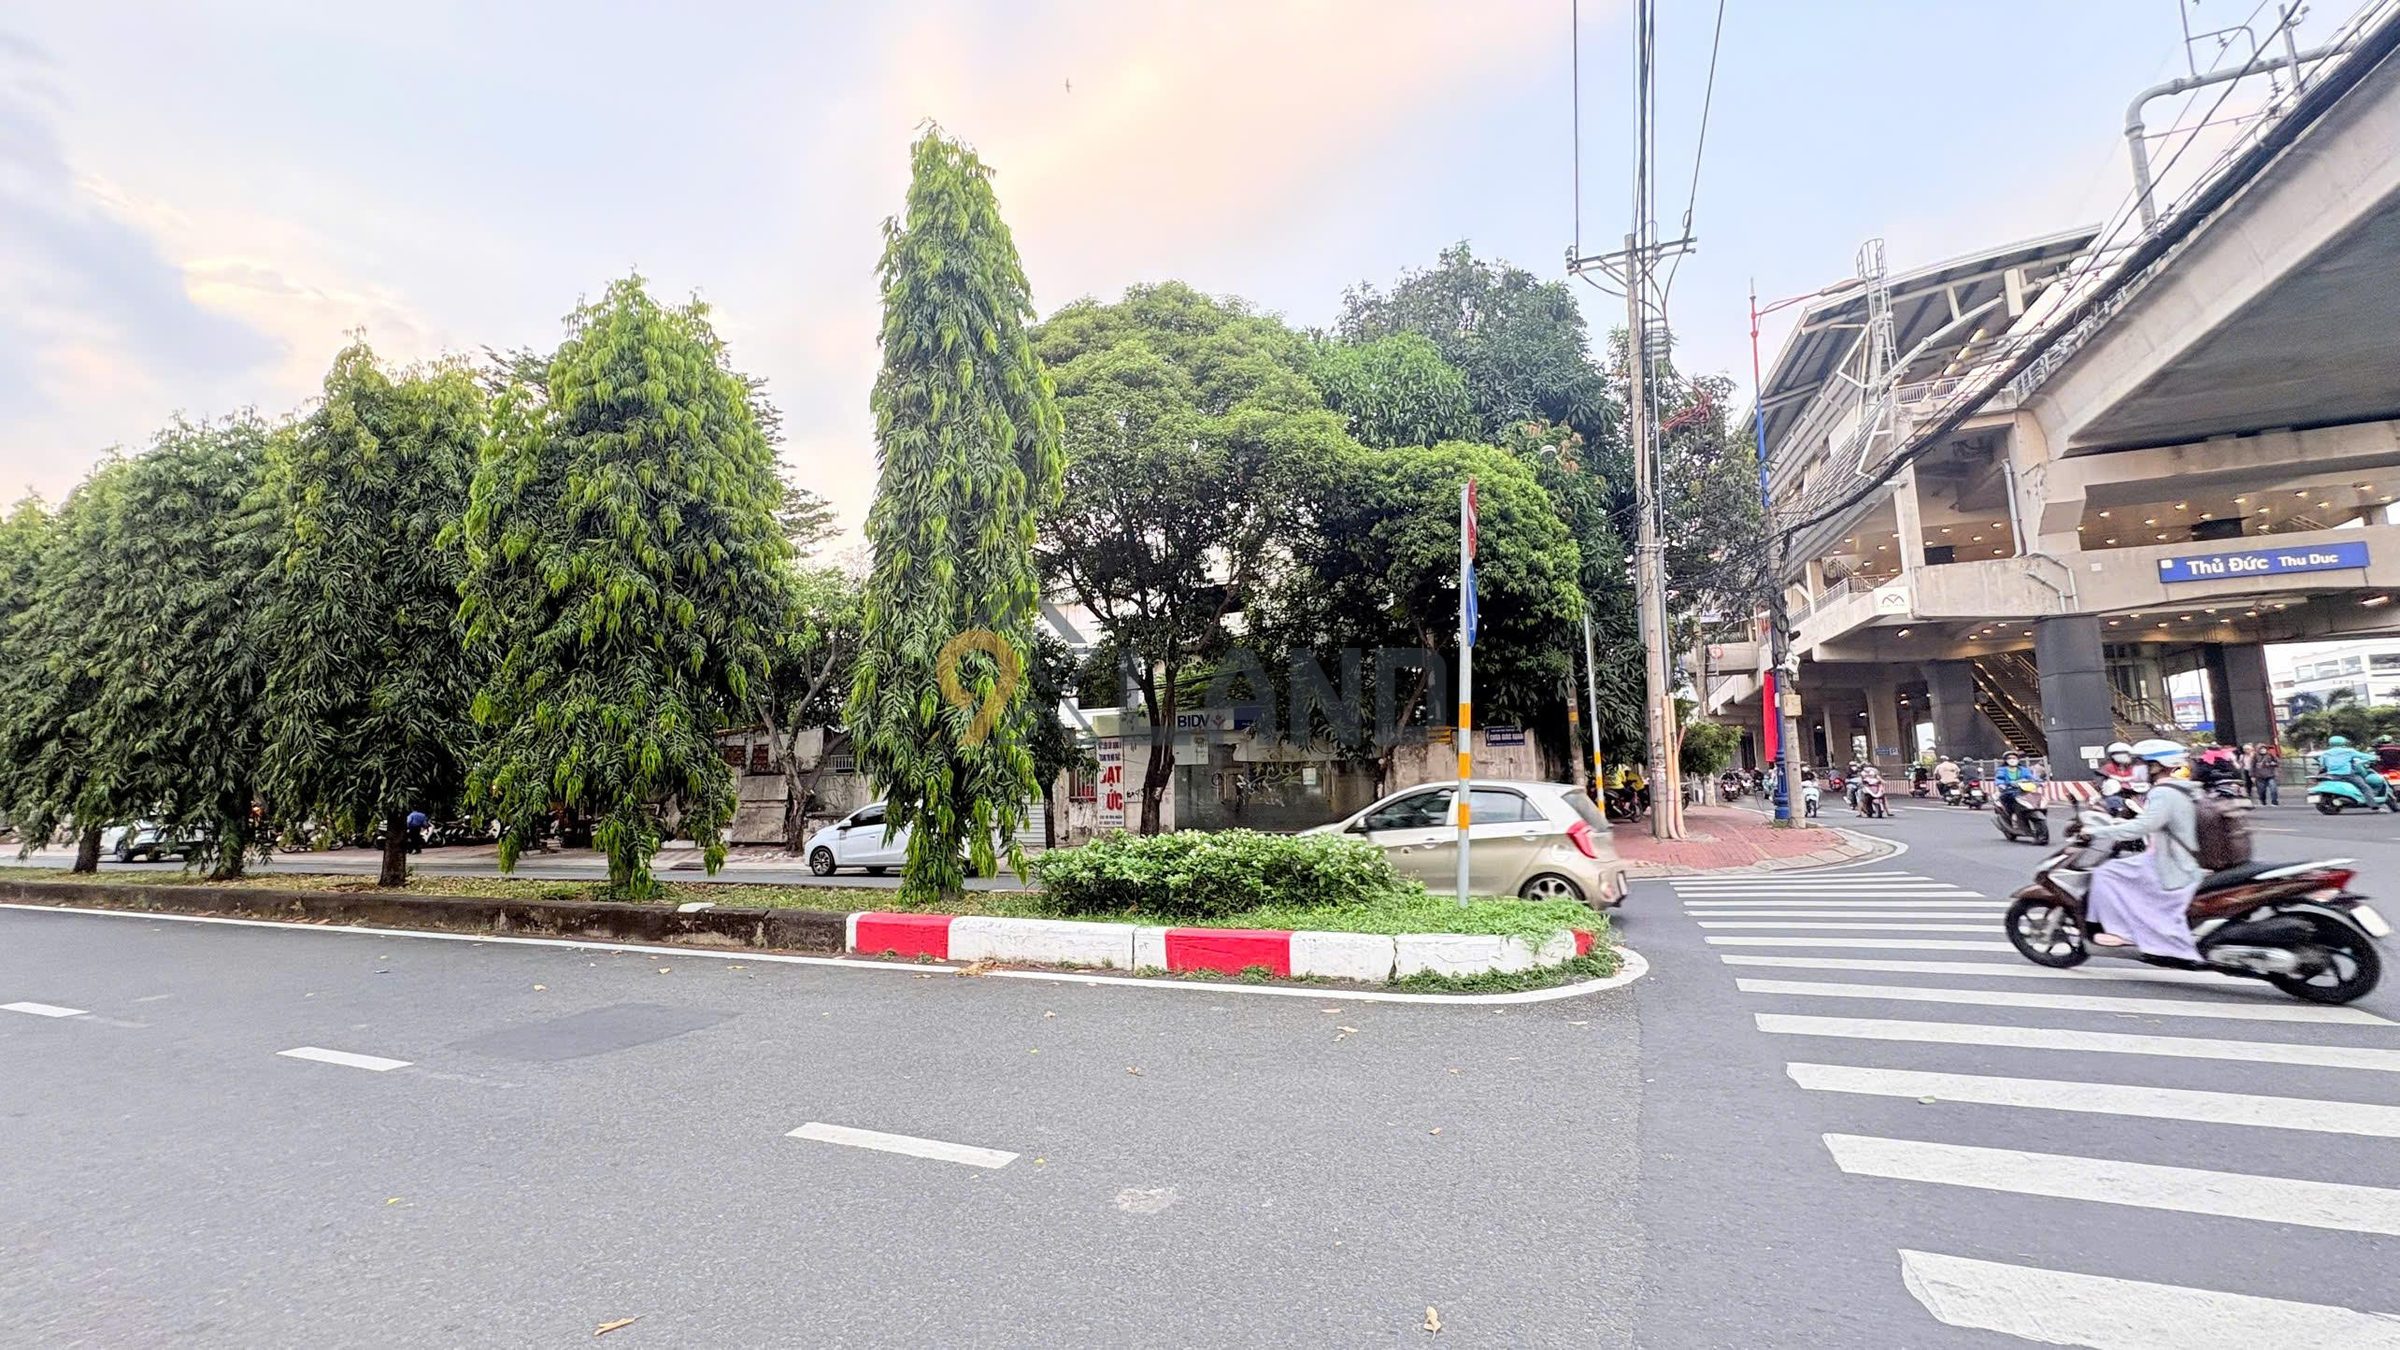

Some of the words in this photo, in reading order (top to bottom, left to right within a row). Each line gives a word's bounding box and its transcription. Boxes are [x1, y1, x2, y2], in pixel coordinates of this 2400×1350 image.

[2186, 557, 2225, 575] Thủ
[2228, 556, 2270, 573] Đức
[2277, 556, 2308, 567] Thu
[2309, 553, 2340, 565] Duc
[1177, 714, 1210, 728] BIDV
